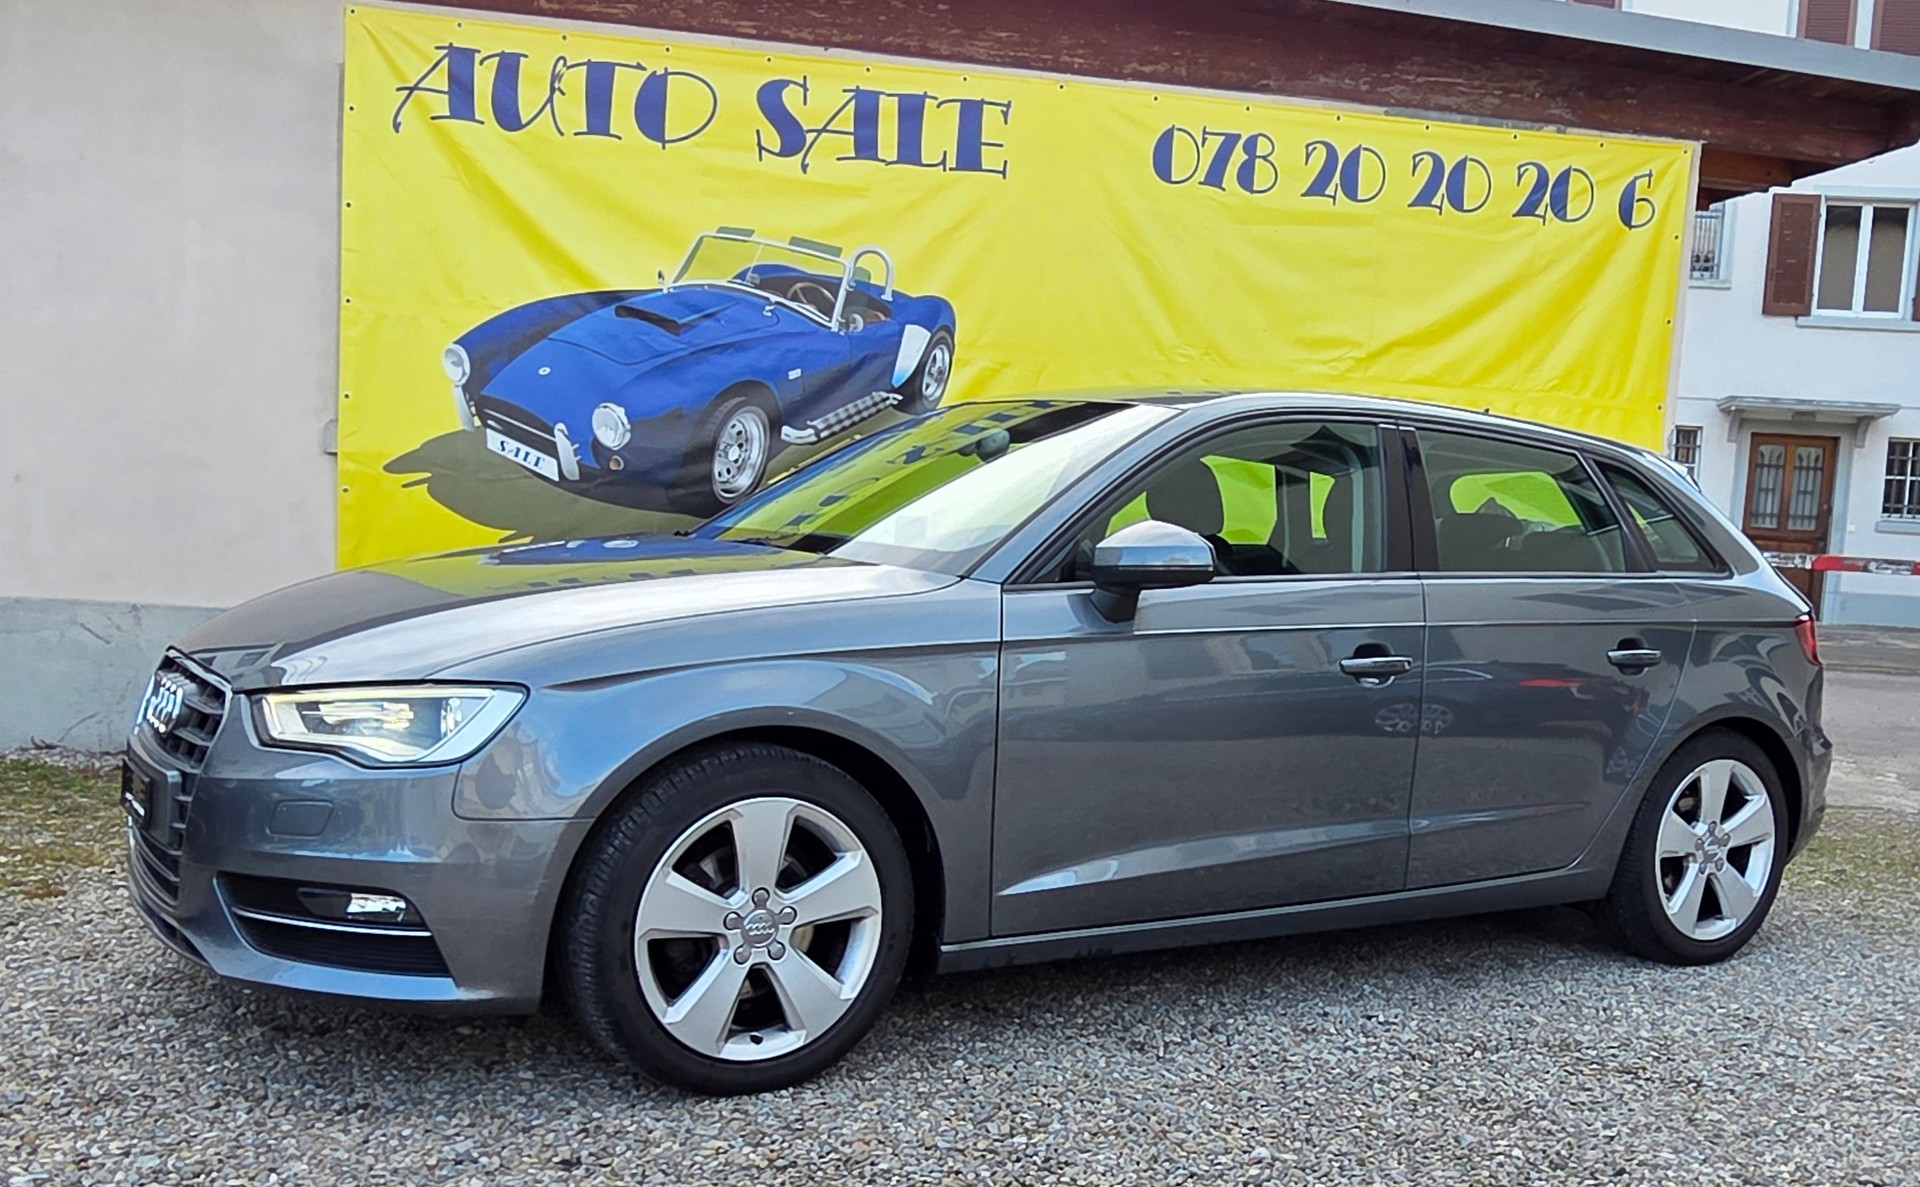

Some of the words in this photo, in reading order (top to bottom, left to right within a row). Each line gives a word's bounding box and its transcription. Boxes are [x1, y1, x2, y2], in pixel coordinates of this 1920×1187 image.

[392, 42, 718, 150] AUTO
[756, 74, 1012, 179] SALE
[1152, 124, 1279, 194] 078
[1301, 140, 1386, 206] 20
[1408, 151, 1492, 215] 20
[1512, 161, 1595, 225] 20
[1618, 168, 1656, 230] 6
[497, 440, 546, 470] SALE
